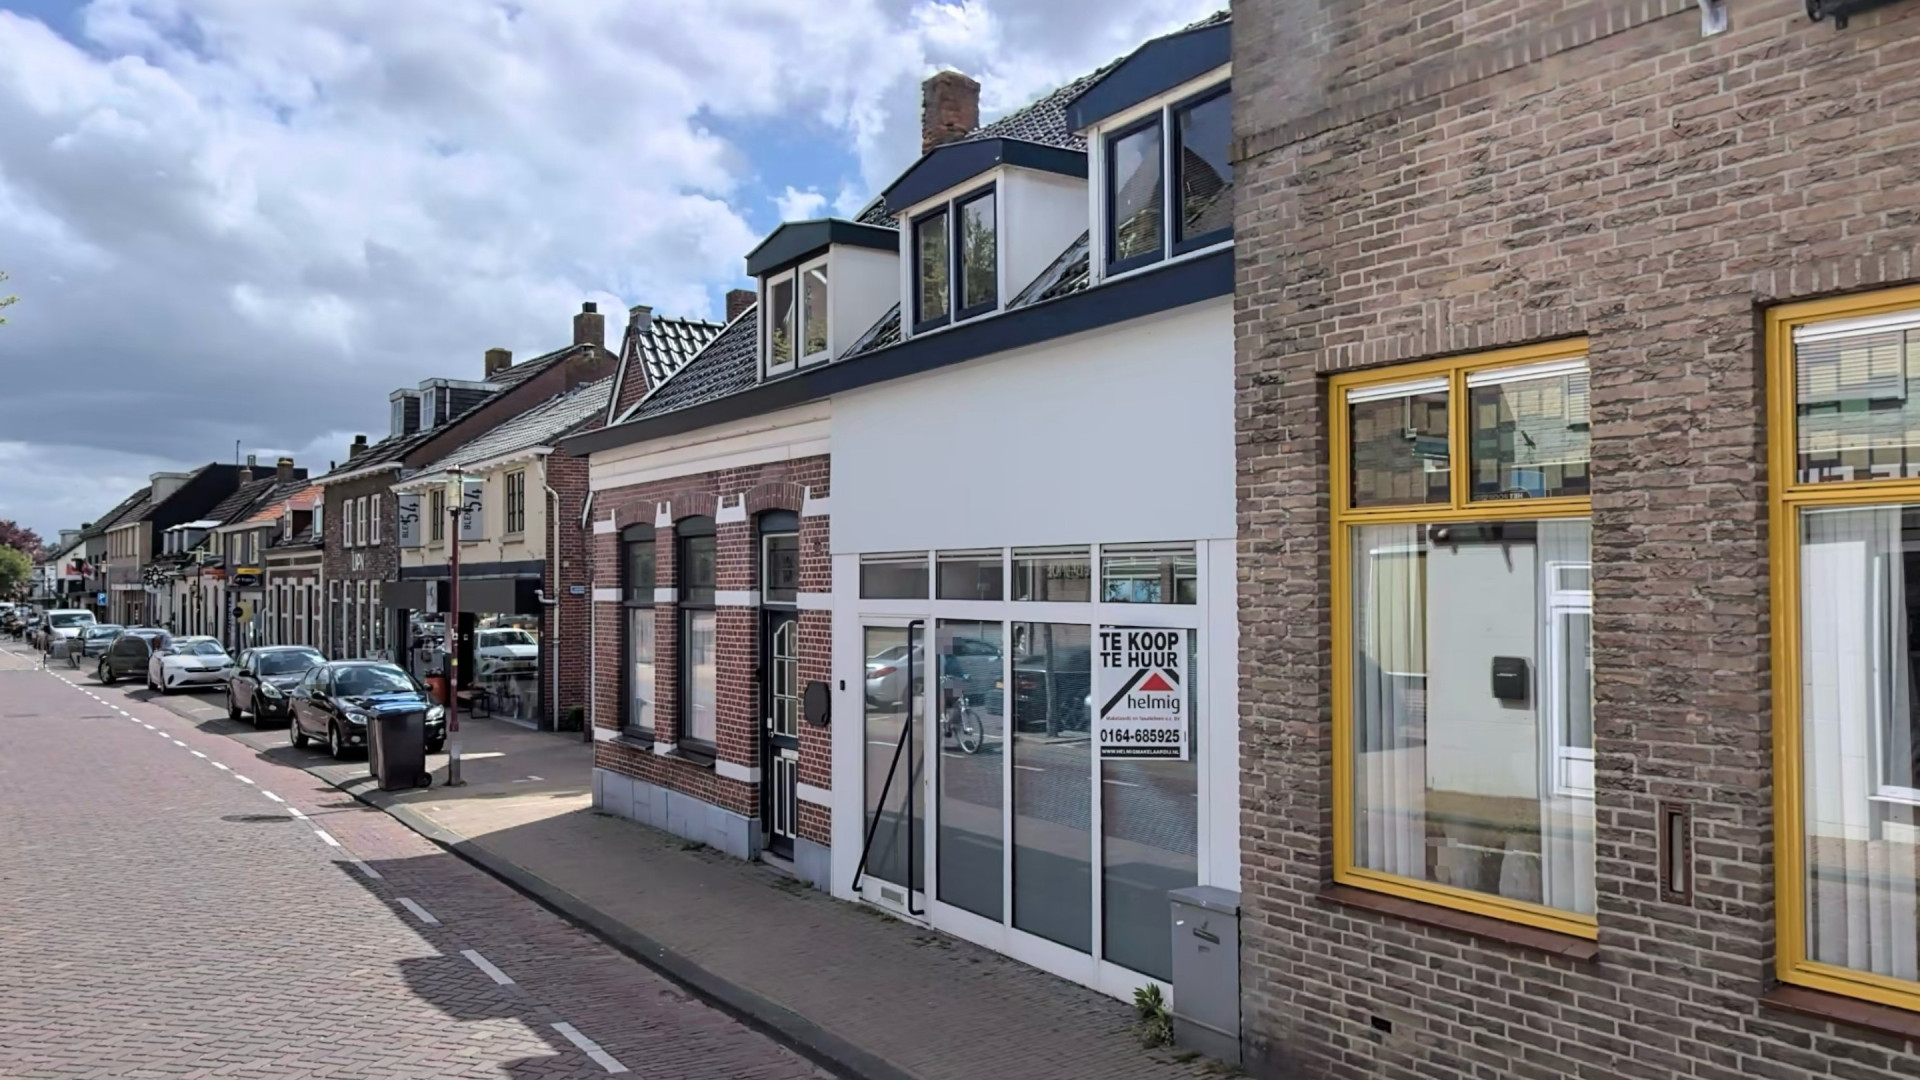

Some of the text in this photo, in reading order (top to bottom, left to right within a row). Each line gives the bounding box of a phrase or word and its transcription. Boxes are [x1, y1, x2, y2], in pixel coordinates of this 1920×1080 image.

[1100, 632, 1179, 651] TE KOOP
[1100, 652, 1178, 668] TE HUUR
[1128, 694, 1180, 714] helmig
[1100, 729, 1180, 743] 0164-685925
